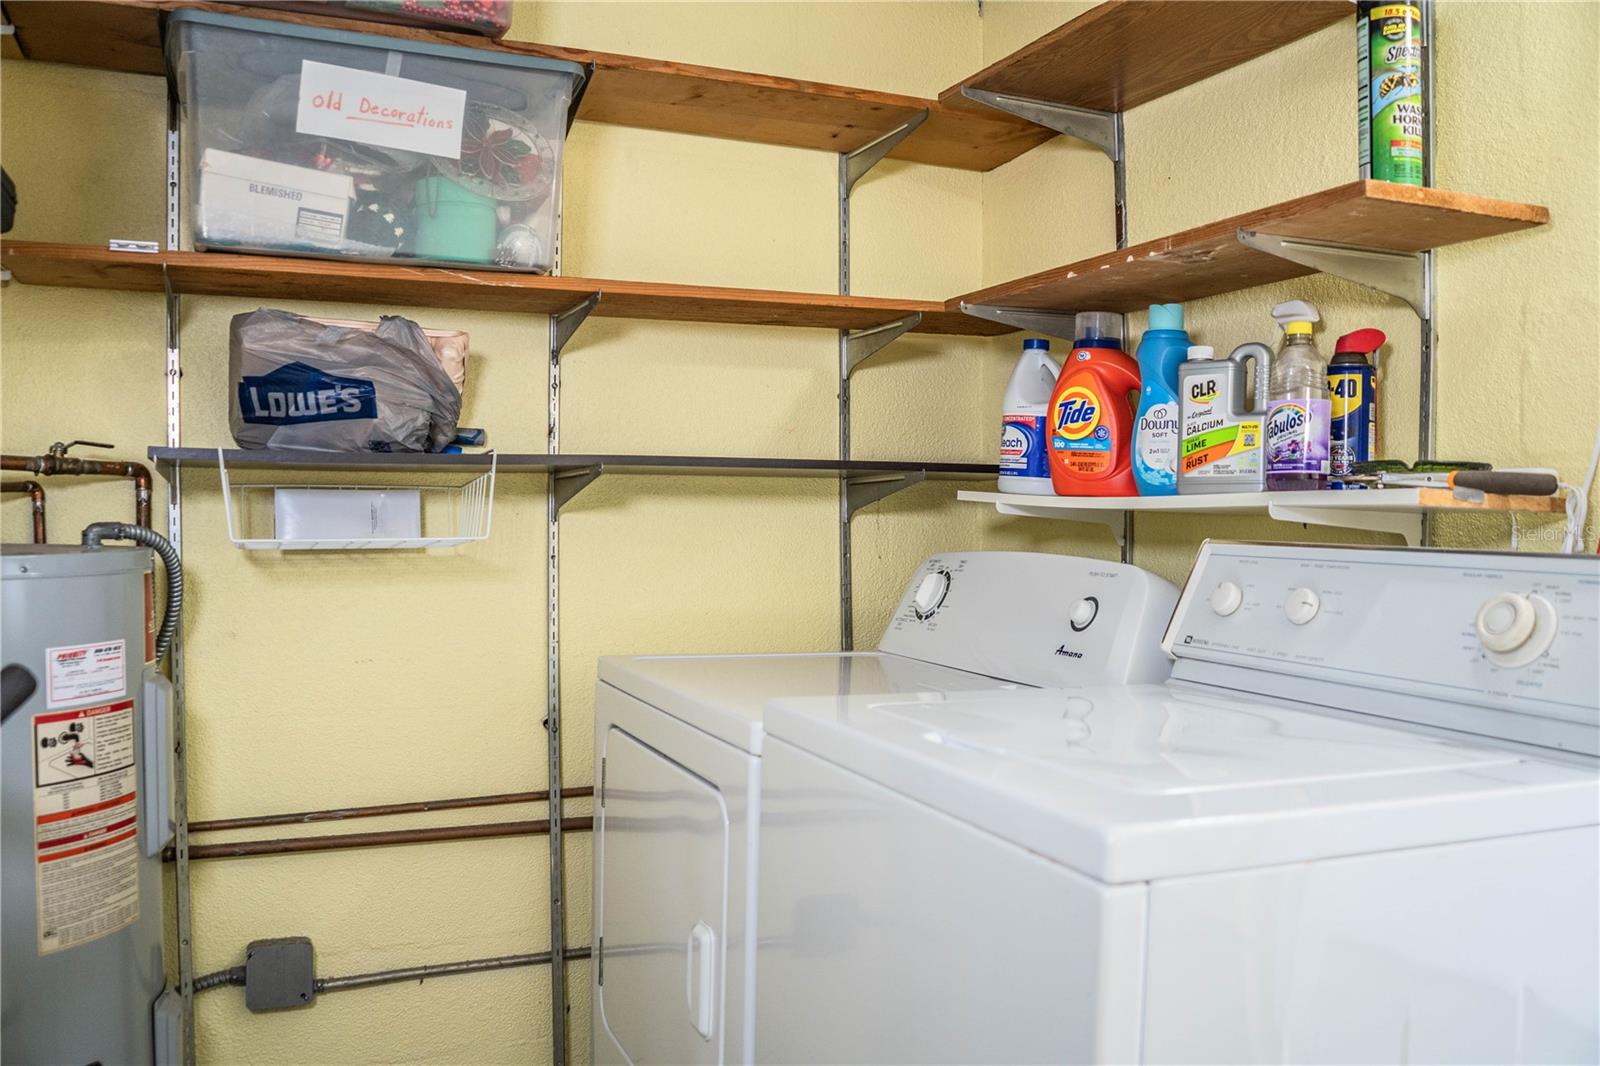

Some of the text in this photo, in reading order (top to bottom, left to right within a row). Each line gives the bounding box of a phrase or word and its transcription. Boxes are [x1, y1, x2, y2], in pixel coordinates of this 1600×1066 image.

[359, 97, 454, 130] Decorations
[249, 183, 303, 202] BLEMISHED
[1191, 379, 1217, 400] CLR
[249, 383, 363, 418] LOWE'S
[1057, 398, 1096, 431] Tide
[1140, 417, 1179, 435] Downy
[1151, 431, 1168, 439] SOFT
[1186, 418, 1224, 437] CALCIUM
[1186, 438, 1208, 453] LIME
[1185, 453, 1209, 471] RUST
[1054, 644, 1083, 659] Amana
